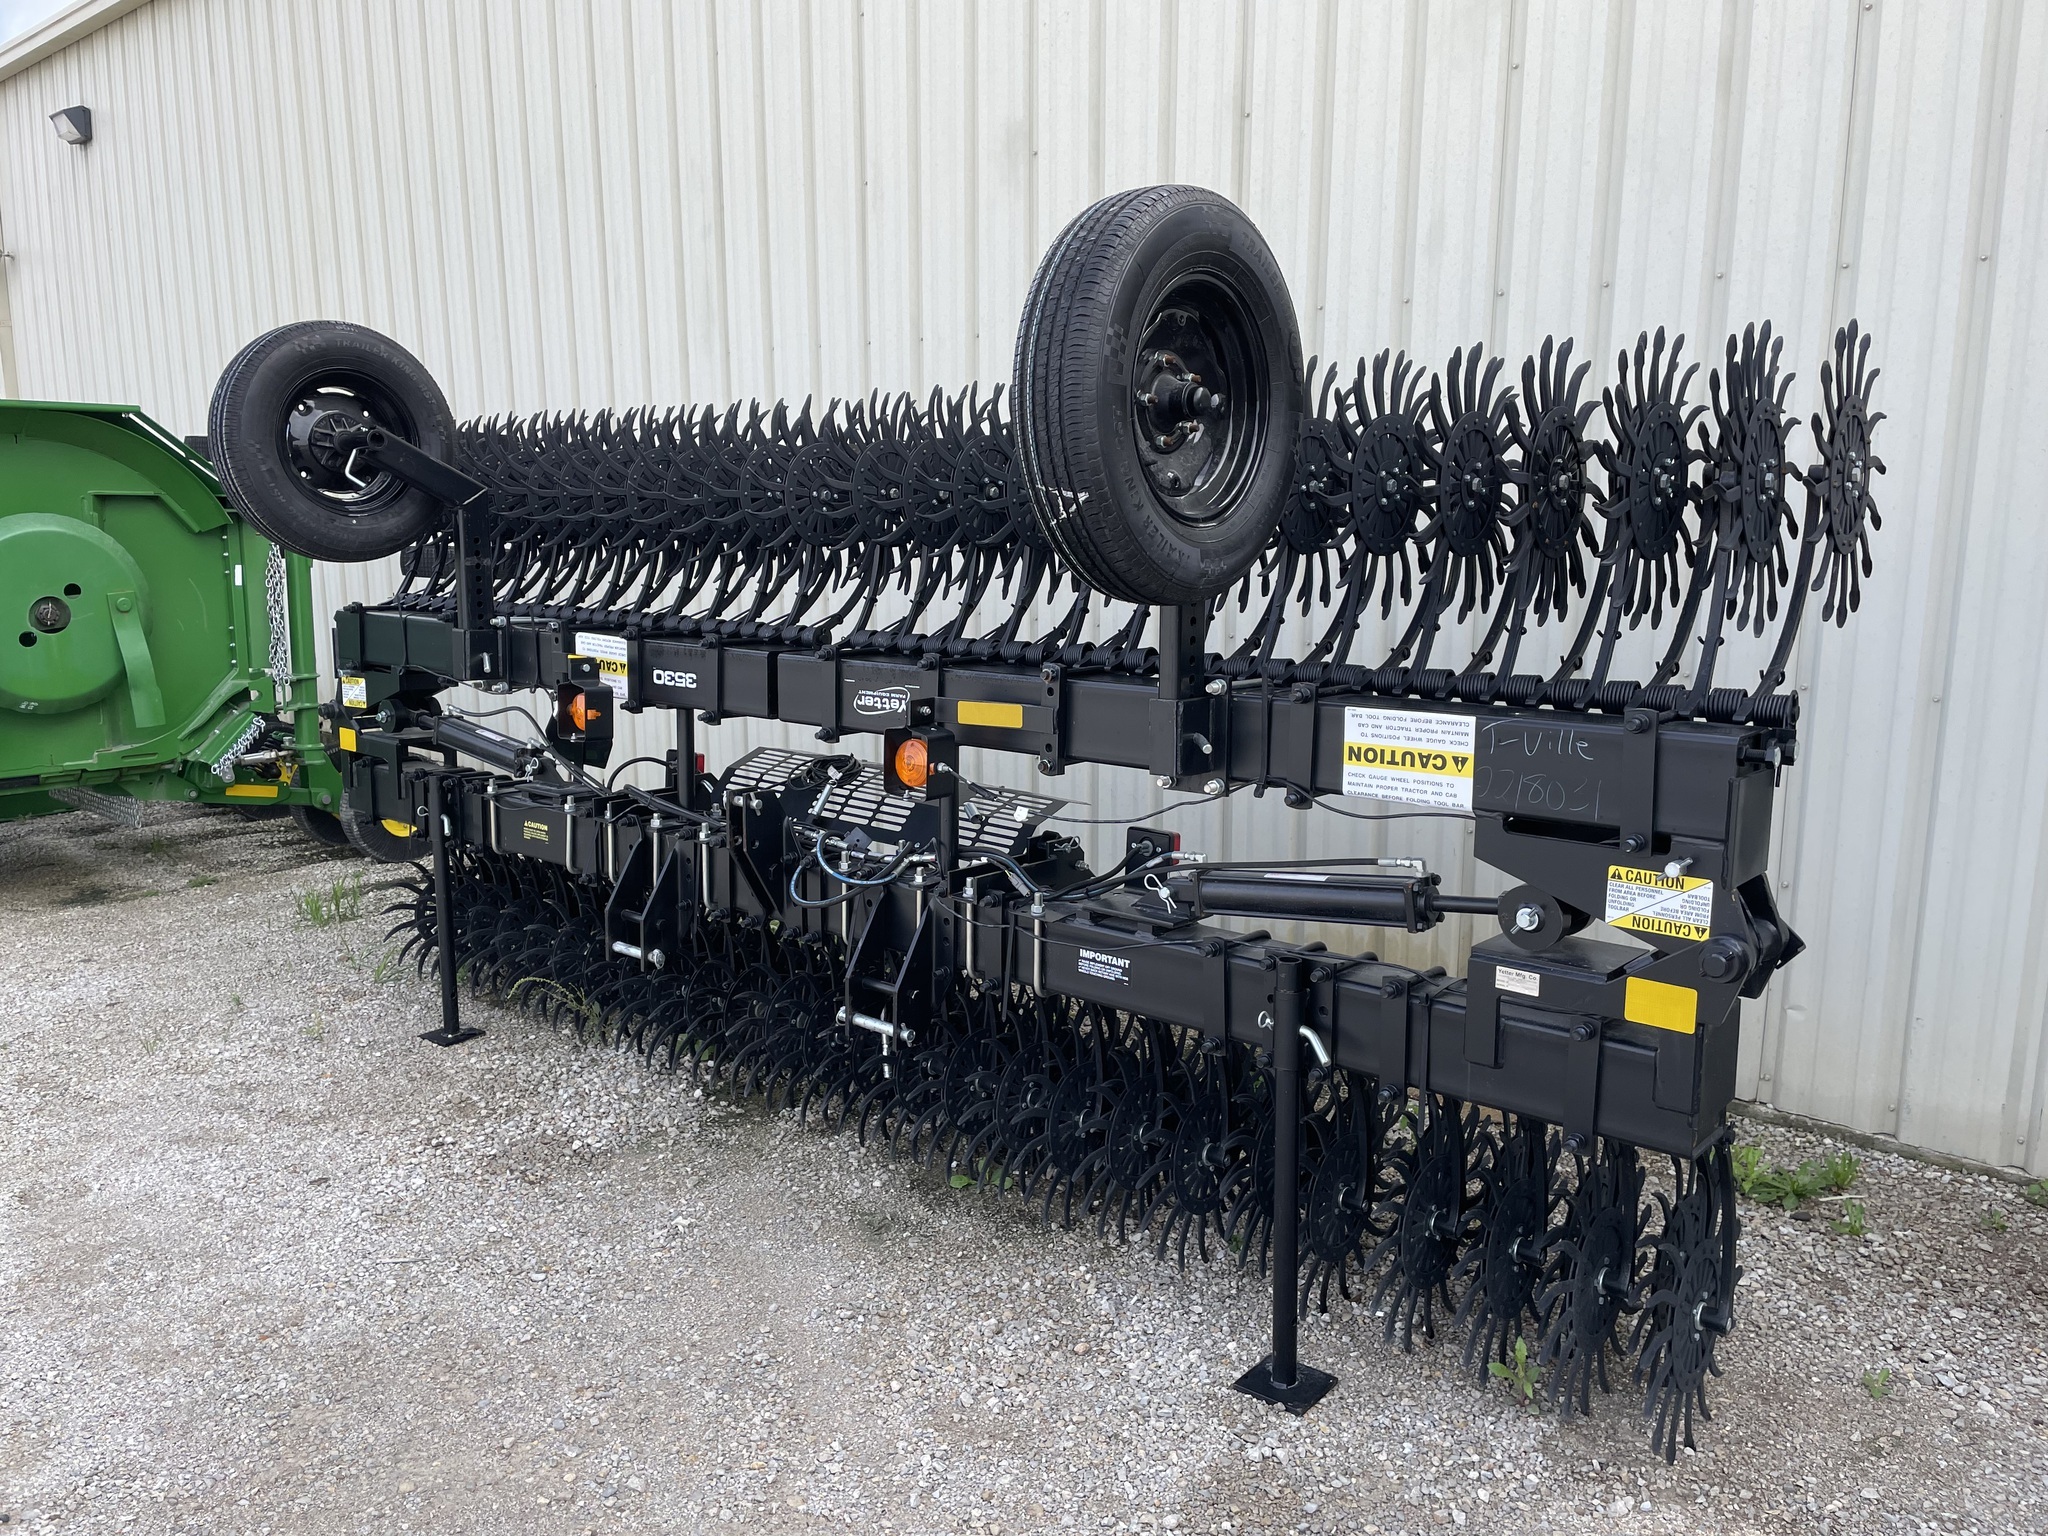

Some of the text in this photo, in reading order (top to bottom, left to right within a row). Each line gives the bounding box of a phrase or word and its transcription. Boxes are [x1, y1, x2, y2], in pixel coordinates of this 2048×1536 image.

[335, 339, 388, 359] TRAILER
[391, 357, 417, 381] KING
[652, 669, 697, 689] 3530
[857, 695, 907, 713] Yetter
[1436, 720, 1470, 728] CLEARANCE
[1348, 745, 1448, 771] CAUTION
[1347, 781, 1374, 789] MAINTAIN
[1401, 787, 1428, 795] TRACTOR
[1412, 779, 1443, 788] POSITIONS
[1347, 790, 1378, 798] CLEARANCE
[1406, 796, 1431, 804] FOLDING
[1625, 869, 1685, 890] CAUTION
[1636, 886, 1664, 895] PERSONNEL
[1608, 899, 1635, 908] UNFOLDING
[1682, 898, 1710, 908] UNFOLDING
[1688, 894, 1710, 902] TOOLBAR
[1608, 904, 1630, 912] TOOLBAR
[1652, 910, 1681, 920] PERSONNEL
[1632, 916, 1691, 937] CAUTION
[1080, 948, 1130, 968] IMPORTANT
